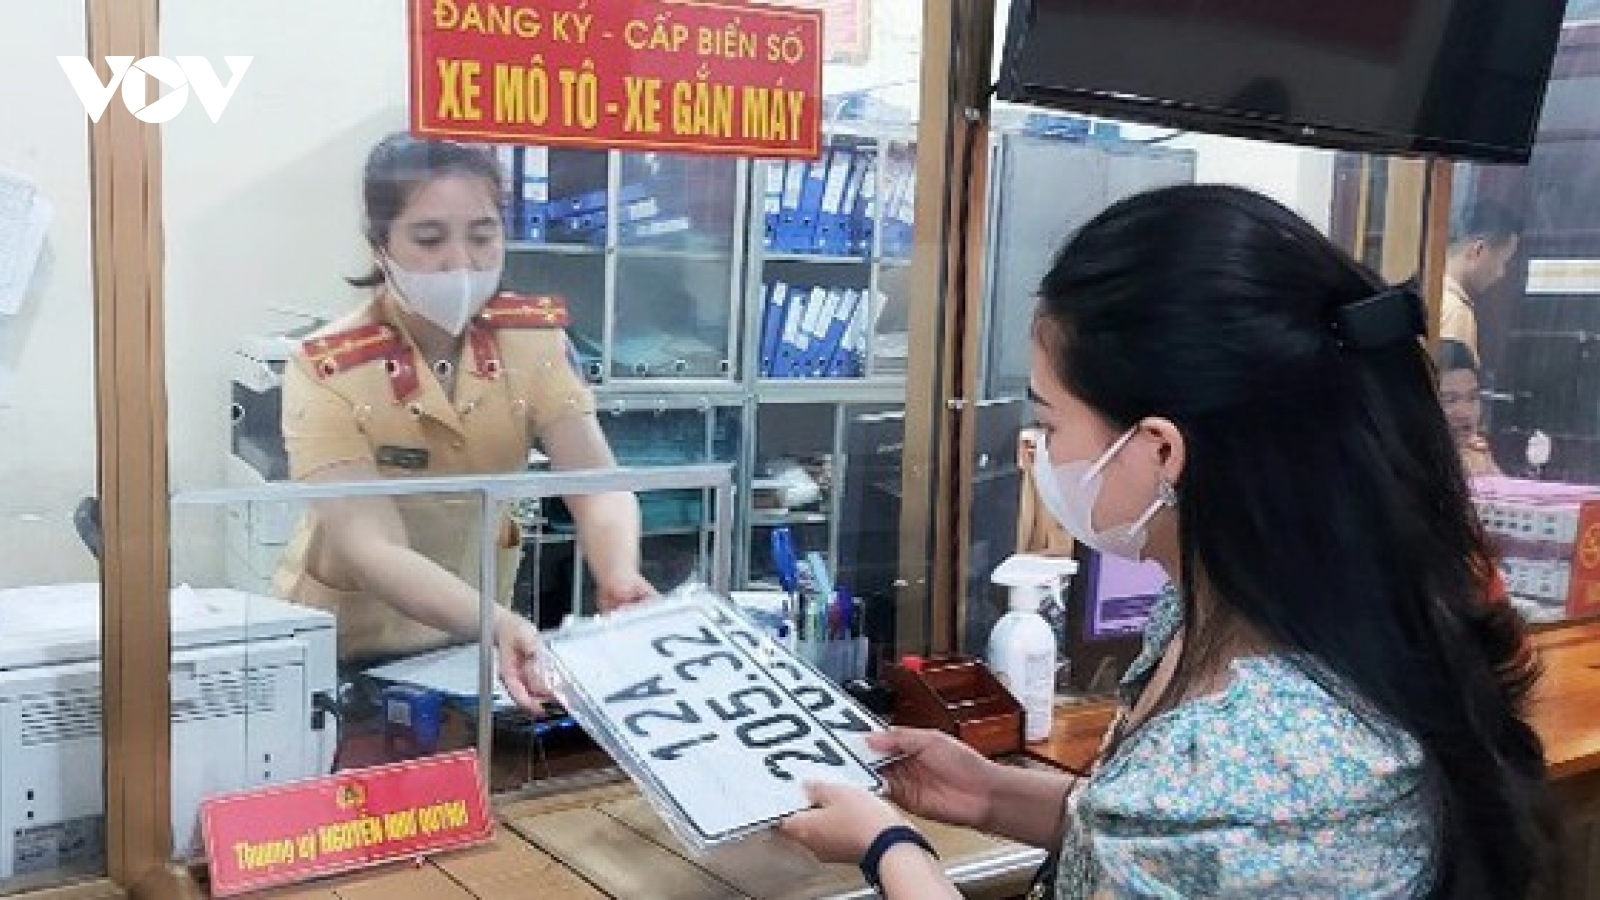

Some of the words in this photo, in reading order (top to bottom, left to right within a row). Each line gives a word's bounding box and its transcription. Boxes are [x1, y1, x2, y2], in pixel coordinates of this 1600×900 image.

[625, 11, 689, 52] CẤP
[767, 25, 804, 65] SỐ
[436, 58, 482, 121] XE
[495, 54, 549, 126] MÔ
[558, 57, 598, 129] TÔ
[623, 76, 662, 133] XE
[673, 62, 735, 138] GẮN
[742, 76, 805, 141] MÁY
[605, 675, 719, 761] 12A
[650, 625, 846, 782] 205.32
